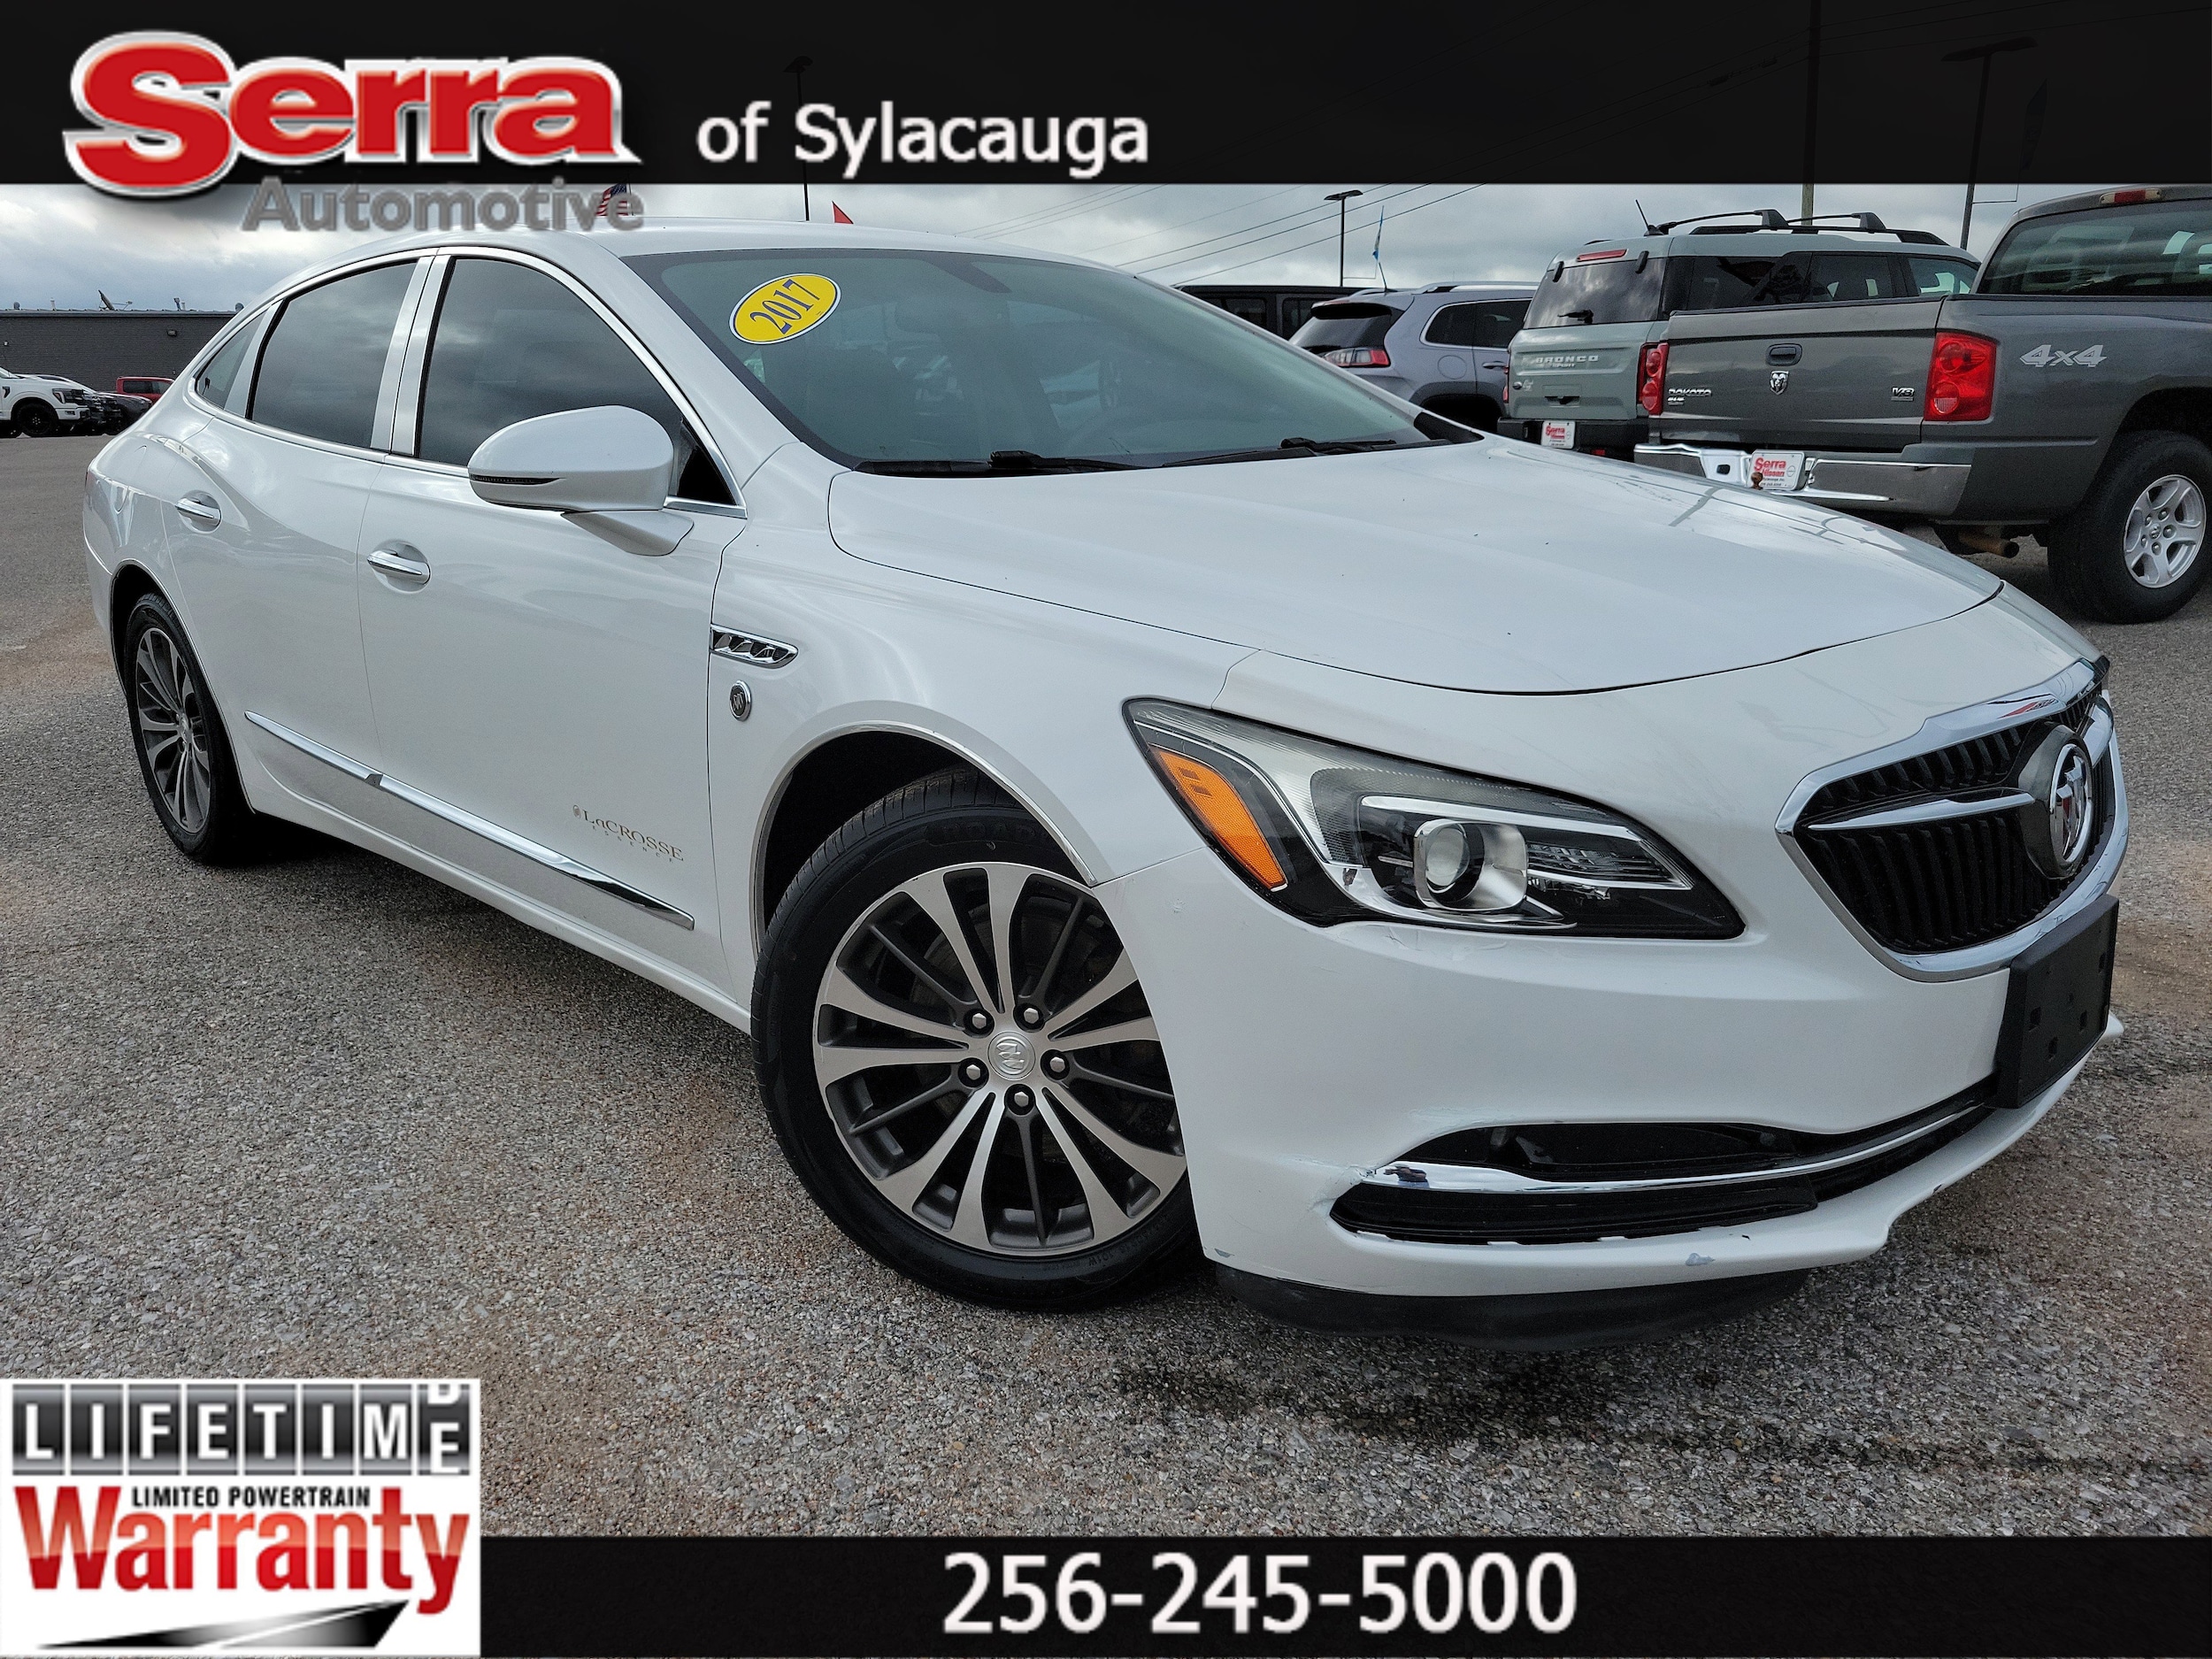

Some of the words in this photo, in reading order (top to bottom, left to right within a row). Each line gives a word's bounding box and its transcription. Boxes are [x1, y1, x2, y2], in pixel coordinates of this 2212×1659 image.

[749, 278, 821, 335] 2017
[1535, 355, 1600, 364] BRONCO
[2019, 344, 2108, 368] 4x4
[1755, 457, 1786, 471] Serra
